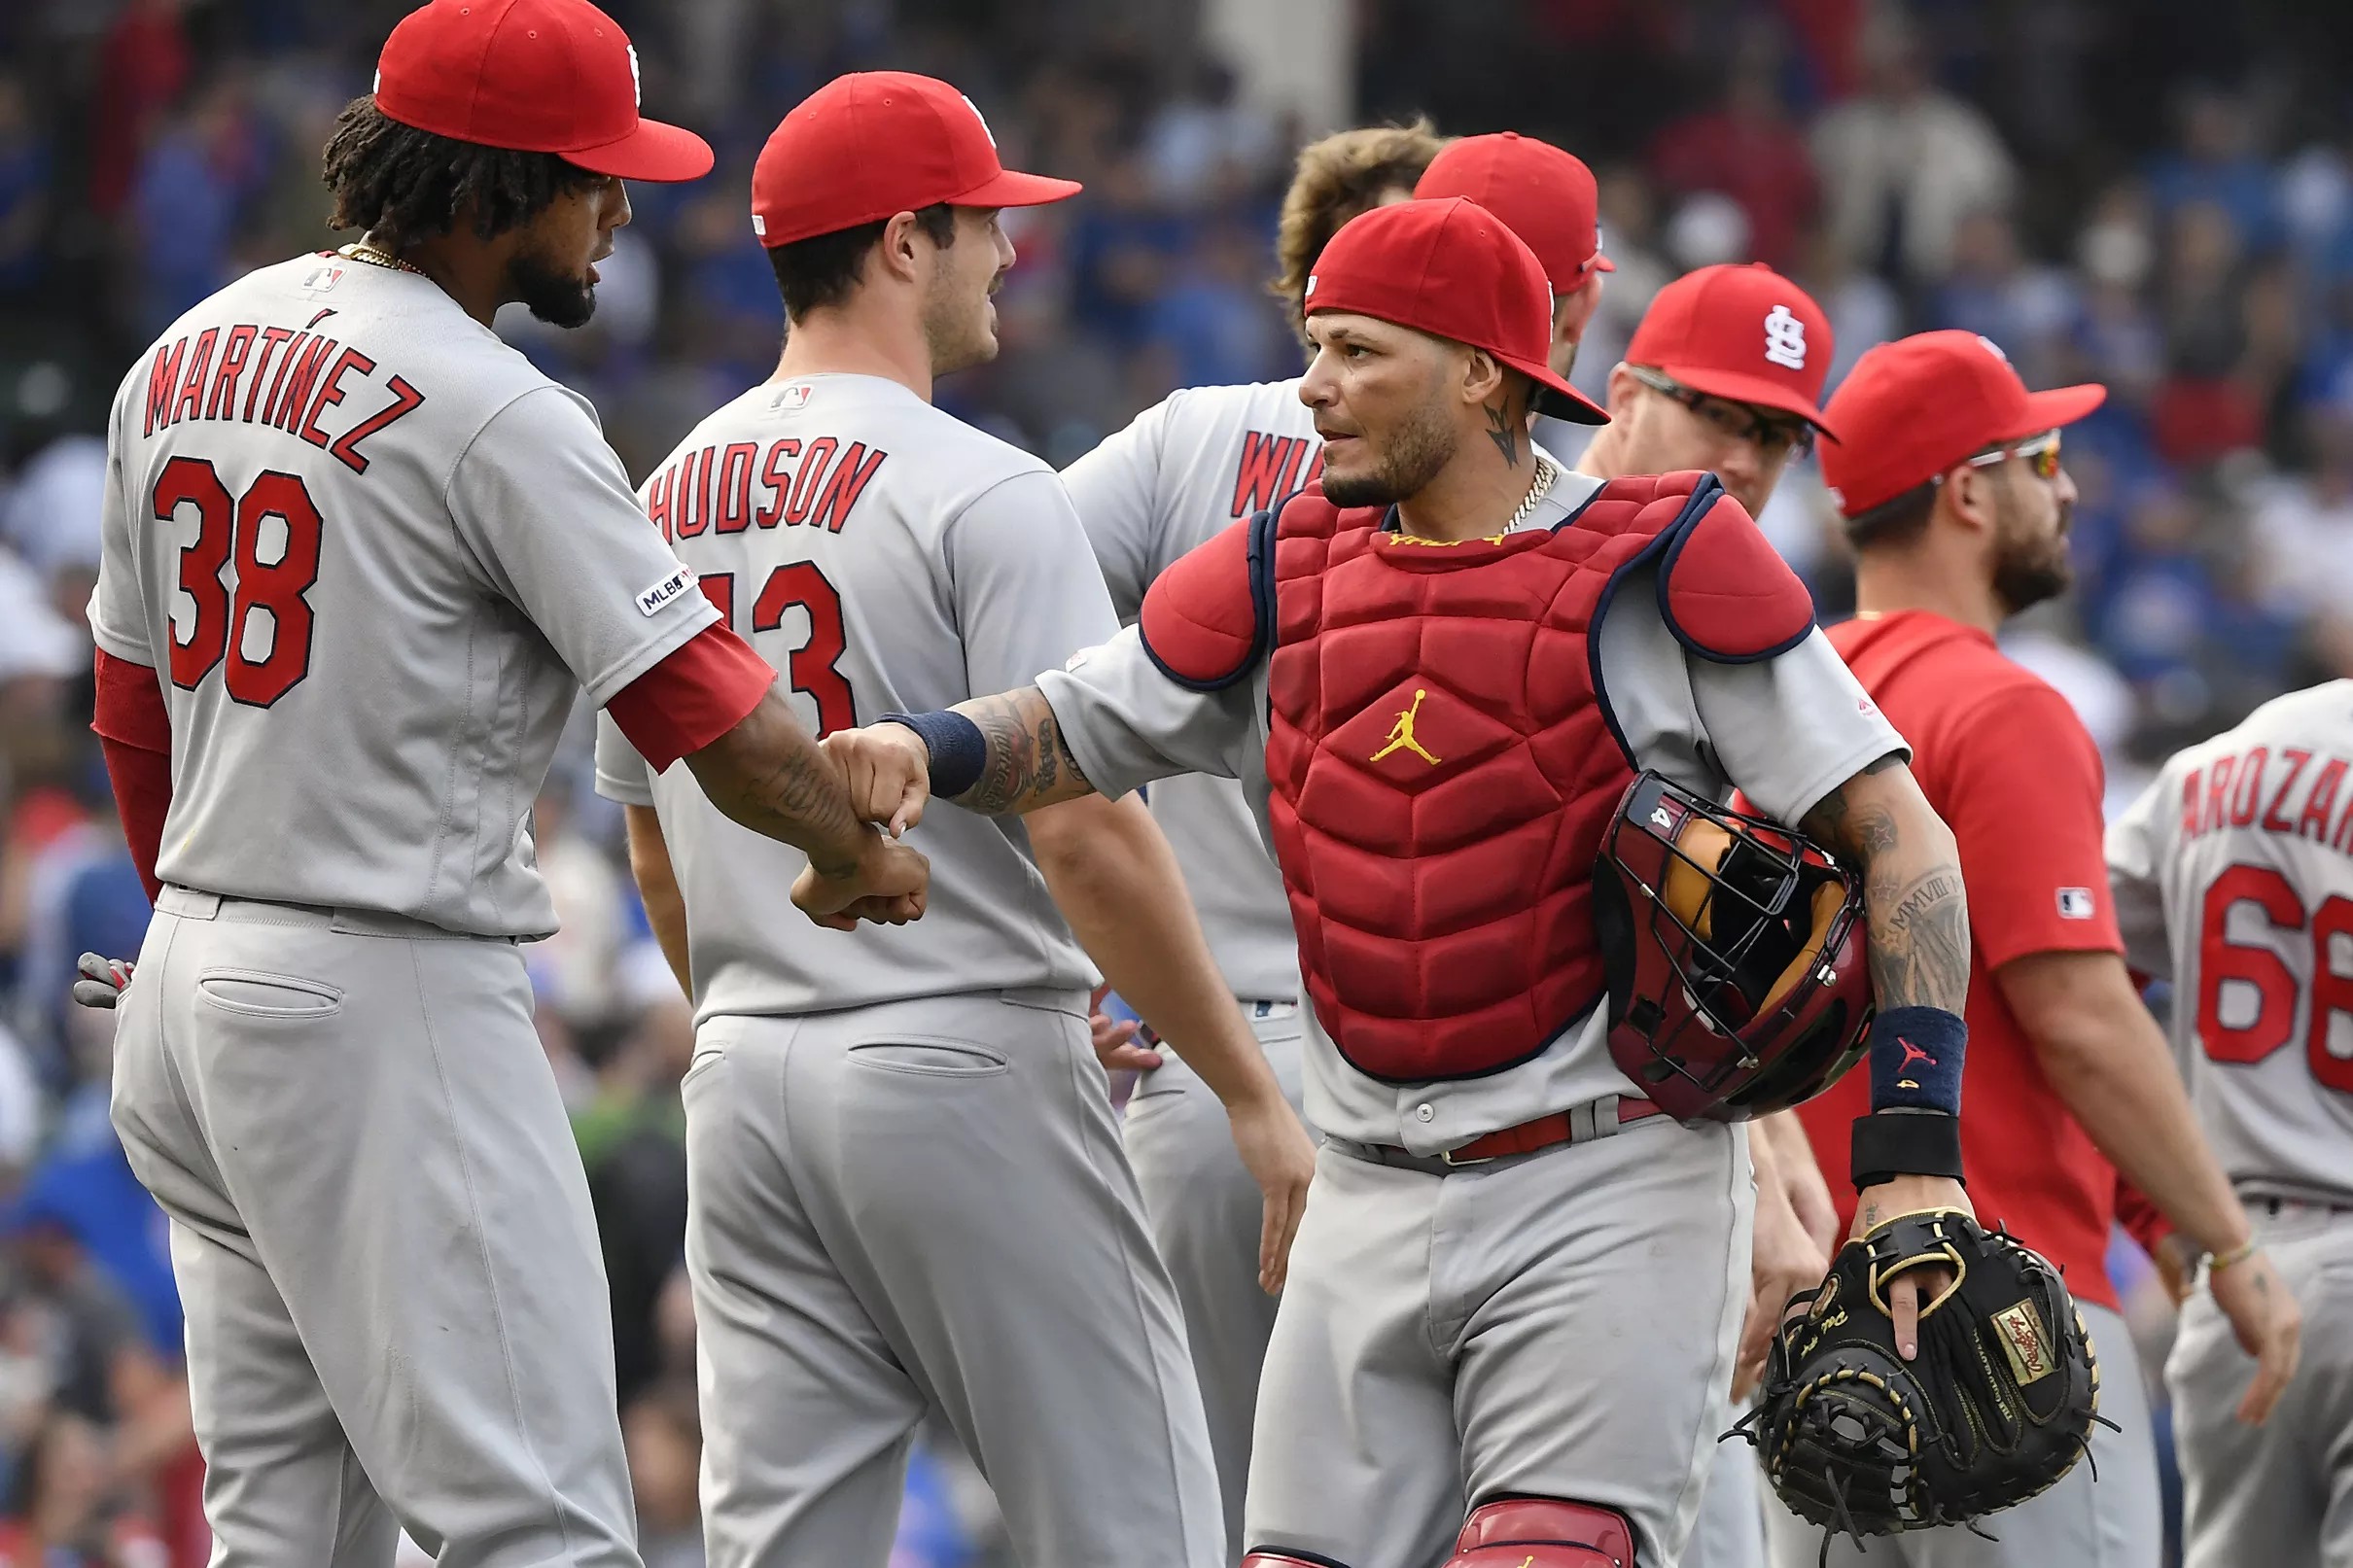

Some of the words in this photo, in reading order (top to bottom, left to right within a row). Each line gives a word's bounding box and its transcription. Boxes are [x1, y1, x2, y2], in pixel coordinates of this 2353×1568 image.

[144, 308, 426, 476] MARTÍNEZ
[649, 436, 888, 544] HUDSON
[153, 456, 324, 710] 38
[643, 581, 677, 610] MLB
[1650, 807, 1671, 828] 4
